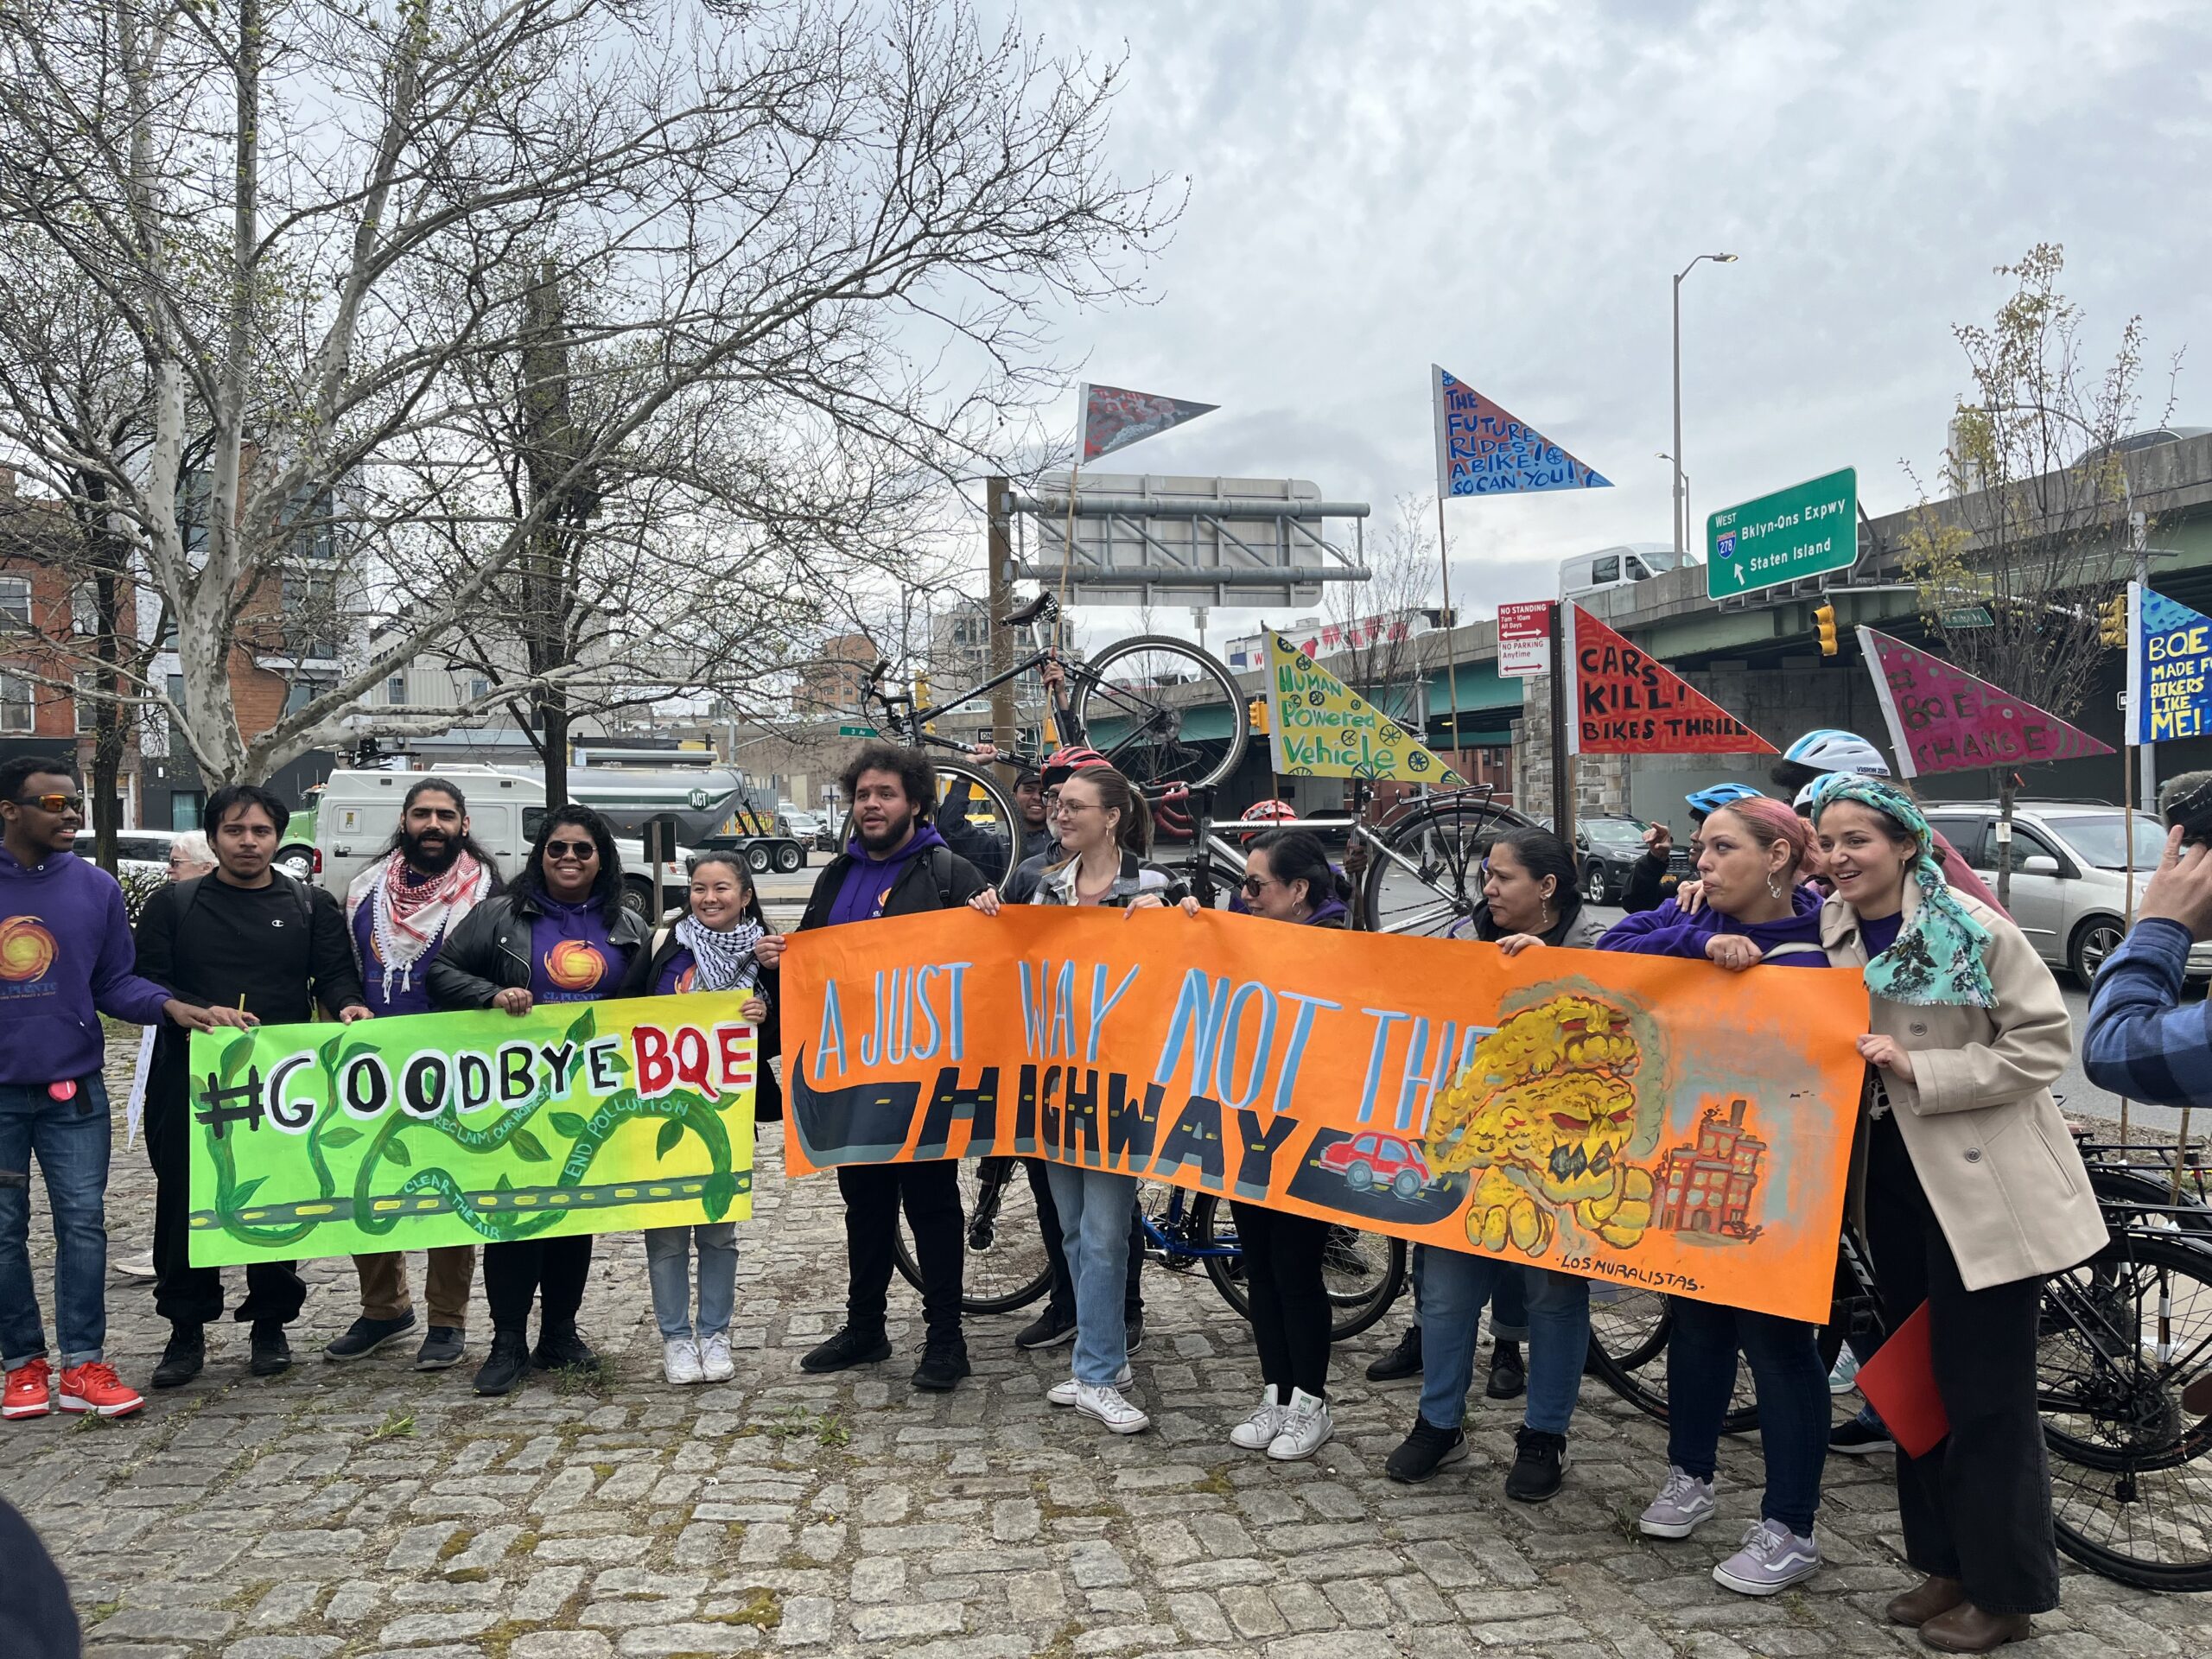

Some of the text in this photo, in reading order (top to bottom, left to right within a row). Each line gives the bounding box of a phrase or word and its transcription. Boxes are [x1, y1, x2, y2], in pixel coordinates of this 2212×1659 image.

[1446, 389, 1478, 410] THE
[1447, 413, 1535, 442] FUTURE
[1449, 435, 1526, 460] RIDES
[1452, 443, 1543, 479] A BIKE!
[1452, 461, 1574, 496] SO CAN YOU!
[1715, 512, 1737, 528] WEST
[1741, 499, 1846, 540] Bklyn-Qns Expwy
[1719, 539, 1733, 554] 278
[1750, 537, 1831, 571] Staten Island
[1512, 603, 1547, 614] STANDING
[1514, 640, 1544, 649] PARKING
[1279, 664, 1343, 697] HUMAN
[1580, 645, 1658, 686] CARS
[2152, 660, 2195, 682] MADE
[1584, 682, 1684, 715] KILL!
[2151, 677, 2205, 698] BIKERS
[1281, 699, 1376, 731] Powered
[1901, 693, 1976, 730] BQE
[2151, 696, 2191, 714] LIKE
[1582, 718, 1748, 741] BIKES THRILL
[2151, 708, 2201, 740] ME!
[1283, 734, 1397, 770] Vehicle
[1917, 725, 2048, 765] CHANGE
[691, 792, 707, 806] ACT
[813, 978, 850, 1080] A
[860, 961, 975, 1068] JUST
[1018, 959, 1141, 1064] WAY
[1154, 967, 1344, 1114] NOT
[433, 1115, 492, 1144] RECLAIM
[493, 1119, 515, 1139] OUR
[564, 1097, 689, 1178] END POLLUTION
[912, 1063, 1300, 1202] HIGHWAY
[404, 1174, 500, 1240] CLEAR THE AIR
[1560, 1255, 1592, 1271] LOS
